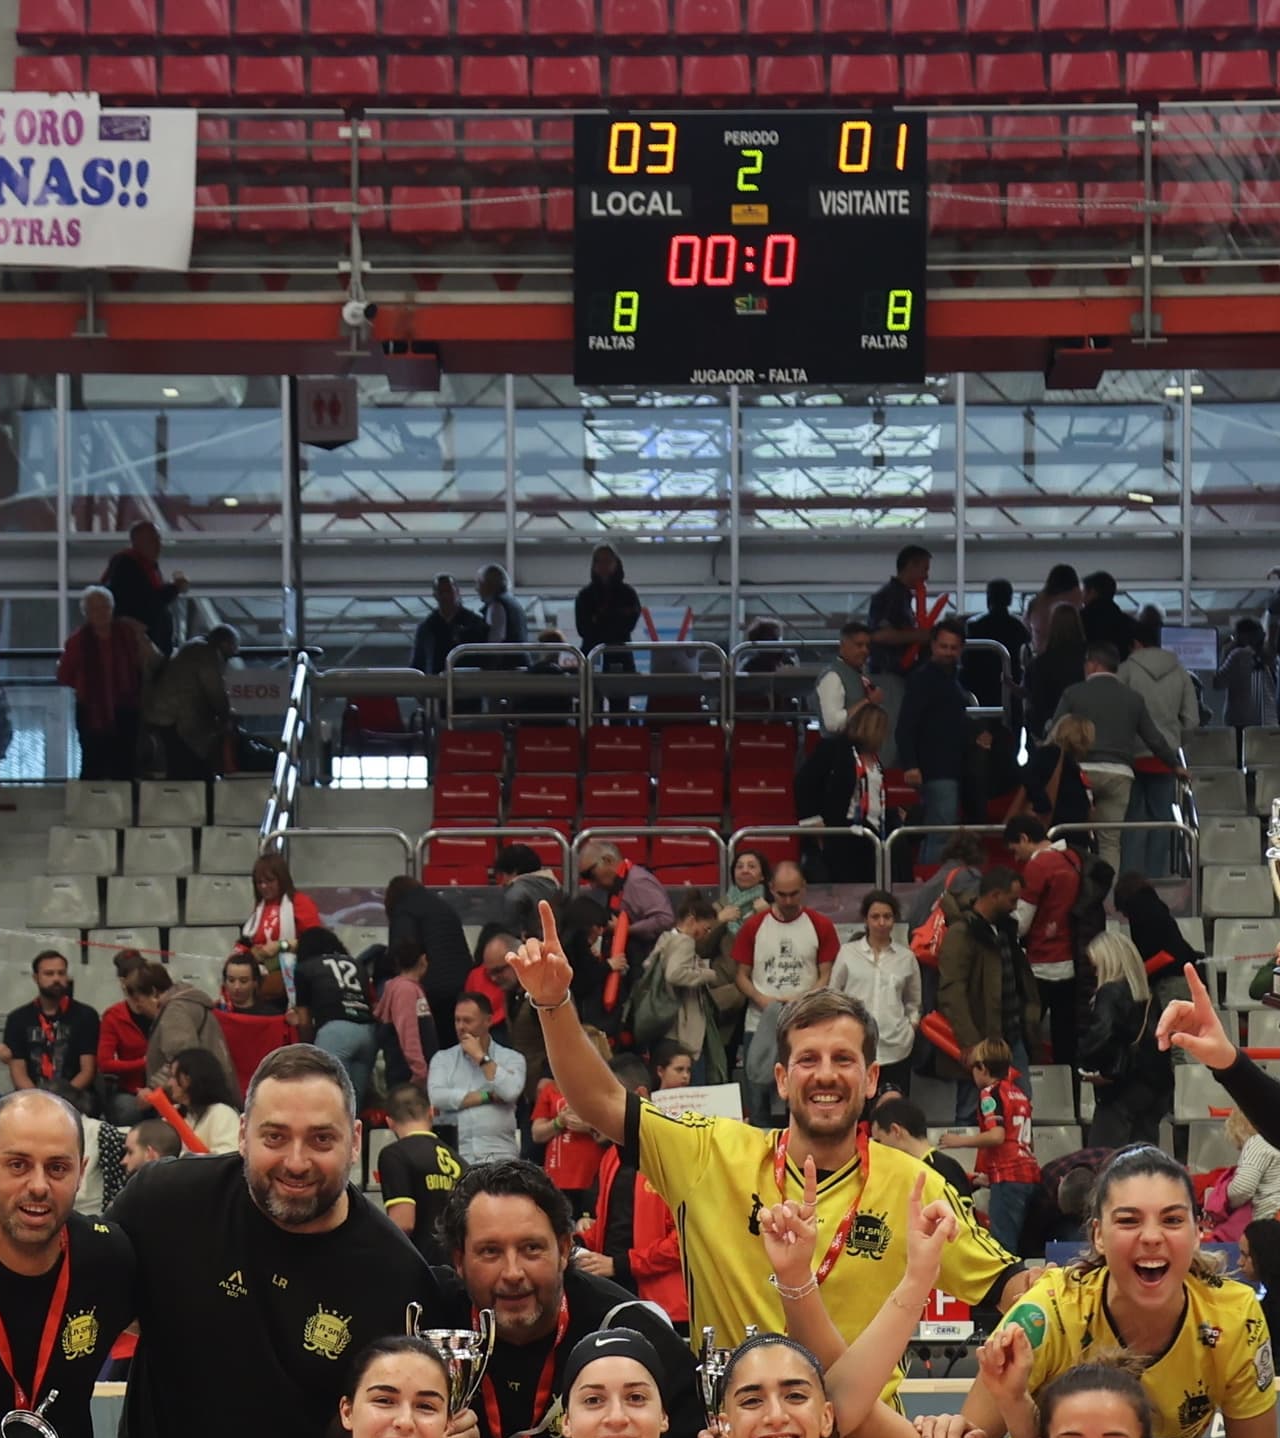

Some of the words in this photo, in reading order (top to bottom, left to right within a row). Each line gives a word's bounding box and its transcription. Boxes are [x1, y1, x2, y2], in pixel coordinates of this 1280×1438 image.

[14, 108, 85, 147] ORO
[724, 131, 780, 147] PERIODO
[607, 121, 678, 175] 03
[838, 120, 908, 174] 01
[736, 149, 764, 192] 2
[590, 190, 683, 217] LOCAL
[819, 190, 911, 216] VISITANTE
[612, 290, 640, 333] 8
[886, 289, 914, 332] 8
[588, 335, 636, 351] FALTAS
[861, 334, 908, 350] FALTAS
[689, 368, 755, 384] JUGADOR
[769, 368, 808, 384] FALTA
[322, 958, 362, 992] 12
[271, 1273, 288, 1289] LR
